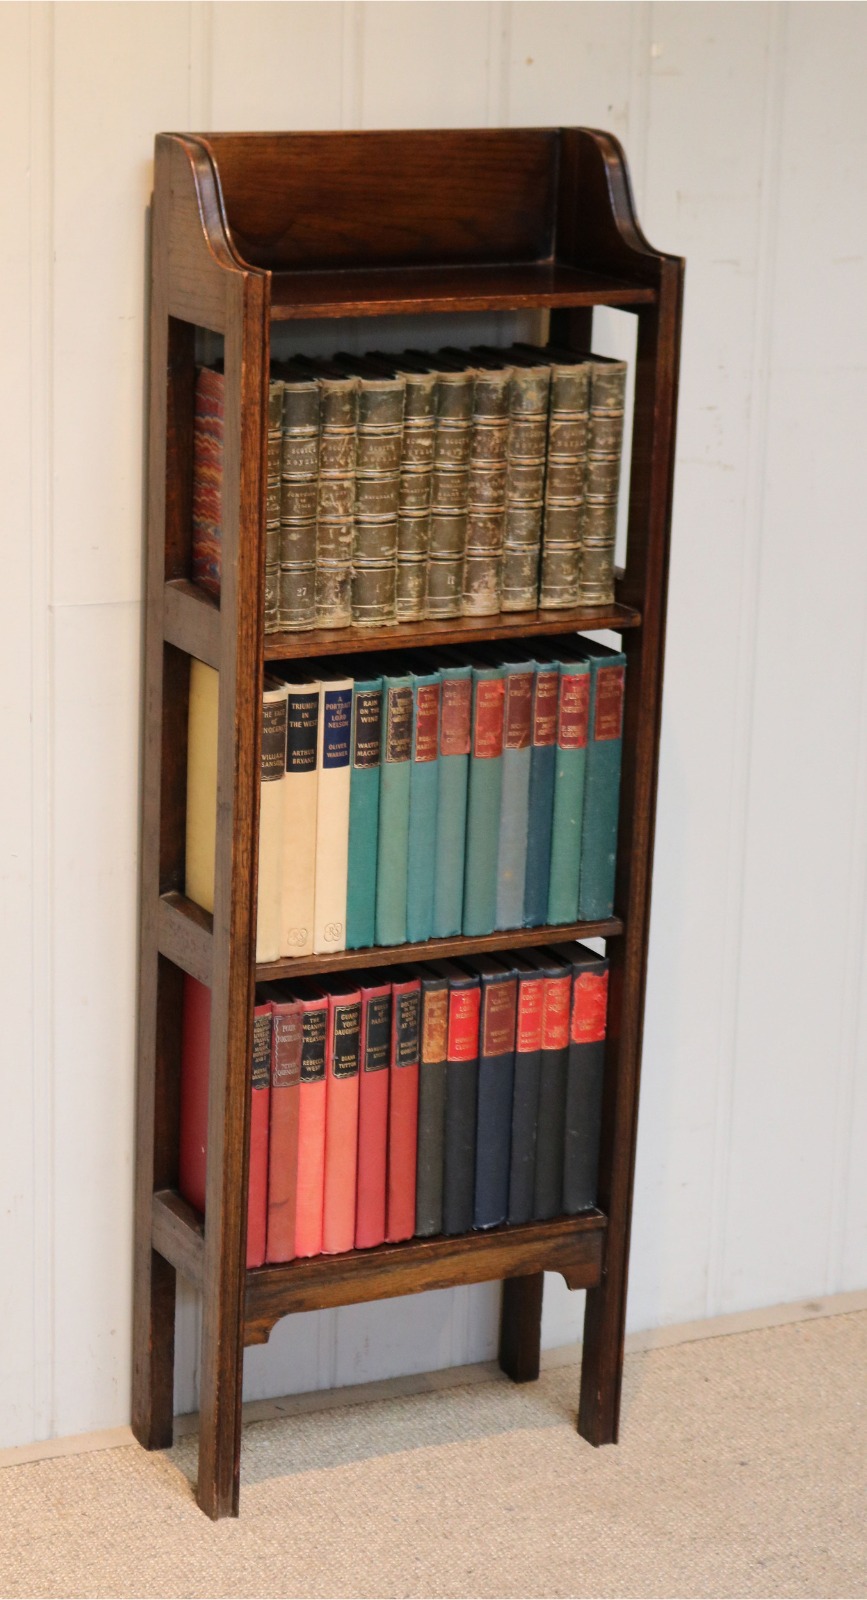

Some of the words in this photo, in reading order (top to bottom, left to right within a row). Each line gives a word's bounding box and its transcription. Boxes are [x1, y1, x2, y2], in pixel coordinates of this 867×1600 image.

[296, 587, 307, 597] 27
[331, 714, 347, 722] LORD
[290, 720, 302, 728] THE
[328, 742, 347, 751] OLIVER
[292, 749, 315, 757] ARTHUR
[292, 757, 315, 765] BRYANT
[342, 1019, 357, 1028] YOUR
[339, 1061, 357, 1069] TUTTON
